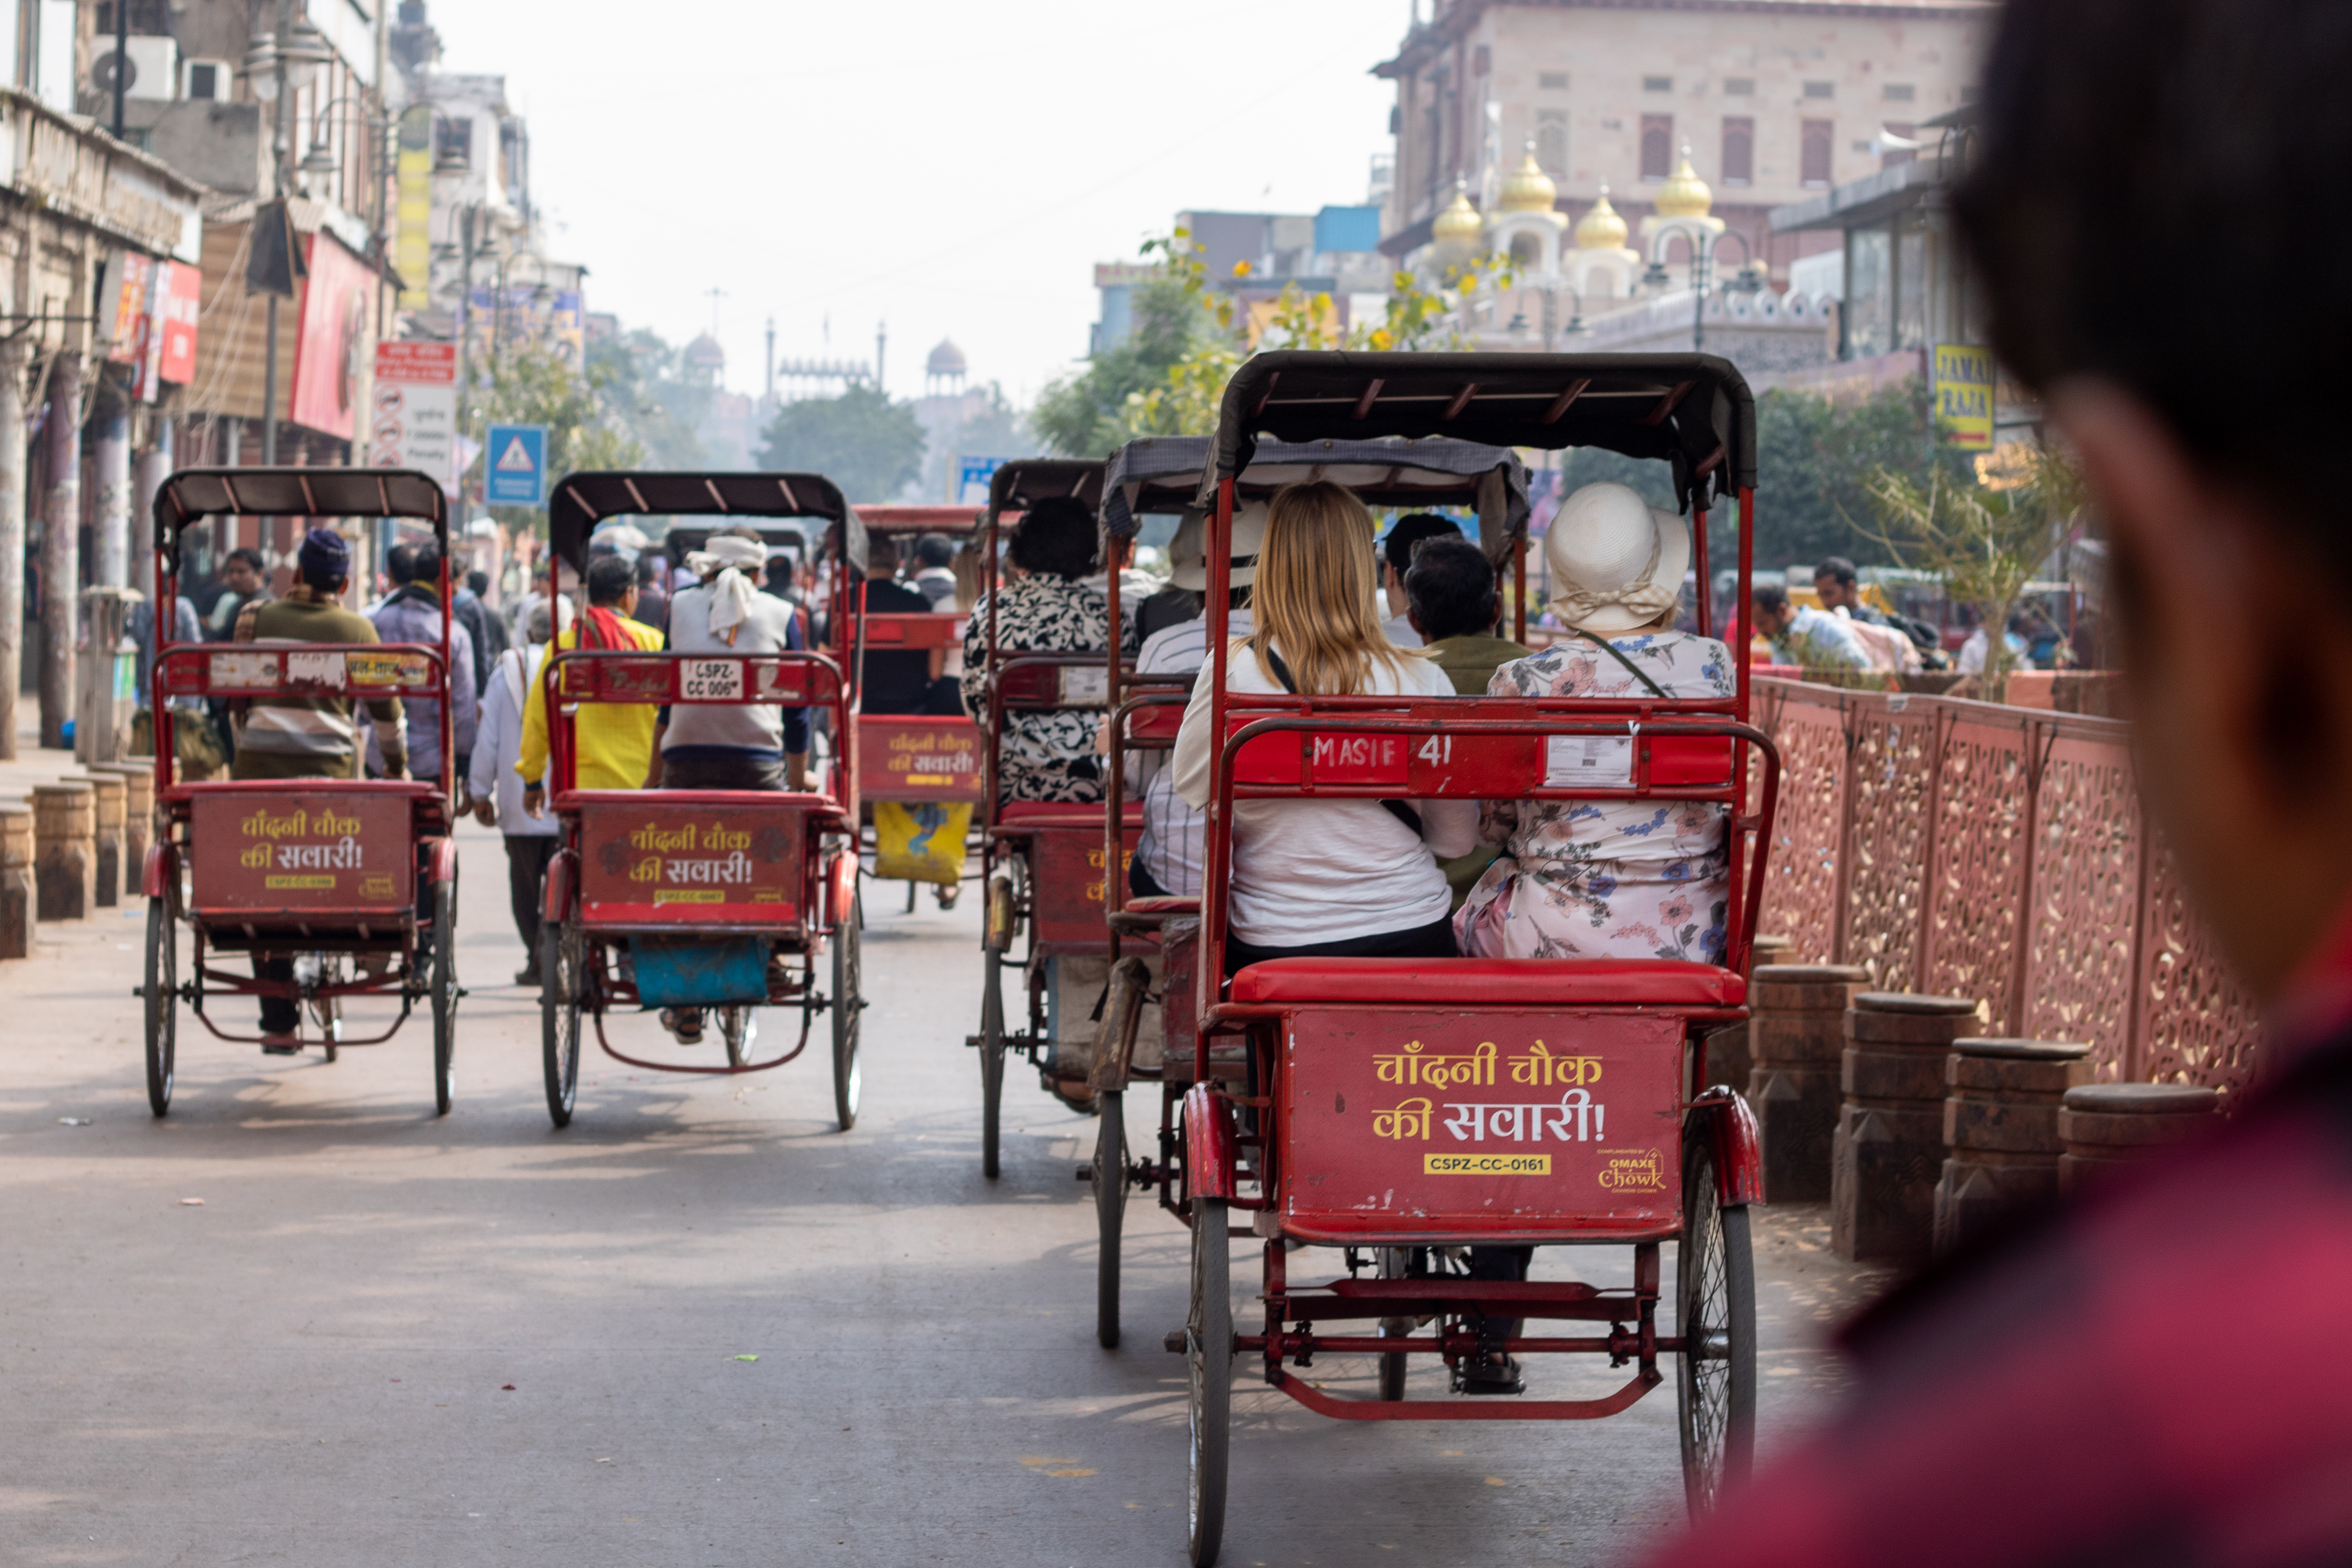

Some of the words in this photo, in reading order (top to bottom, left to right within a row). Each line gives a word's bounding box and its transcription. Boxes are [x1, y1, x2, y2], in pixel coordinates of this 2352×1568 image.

[687, 681, 704, 695] CC
[1417, 734, 1451, 768] 41
[241, 809, 307, 839] चाँदनी
[313, 809, 361, 837] चौक
[630, 822, 696, 853] चाँदनी
[702, 822, 751, 851] चौक
[241, 842, 272, 869] की
[277, 836, 363, 870] सवारी!
[629, 856, 661, 883] की
[666, 851, 753, 883] सवारी!
[1372, 1040, 1499, 1090] चाँदनी
[1507, 1039, 1603, 1085] चौक
[1371, 1097, 1434, 1140] की
[1443, 1088, 1604, 1142] सवारी!
[1430, 1158, 1544, 1170] CSPZ-CC-0161
[1598, 1168, 1667, 1189] Chowk
[1609, 1159, 1656, 1168] OMAXE
